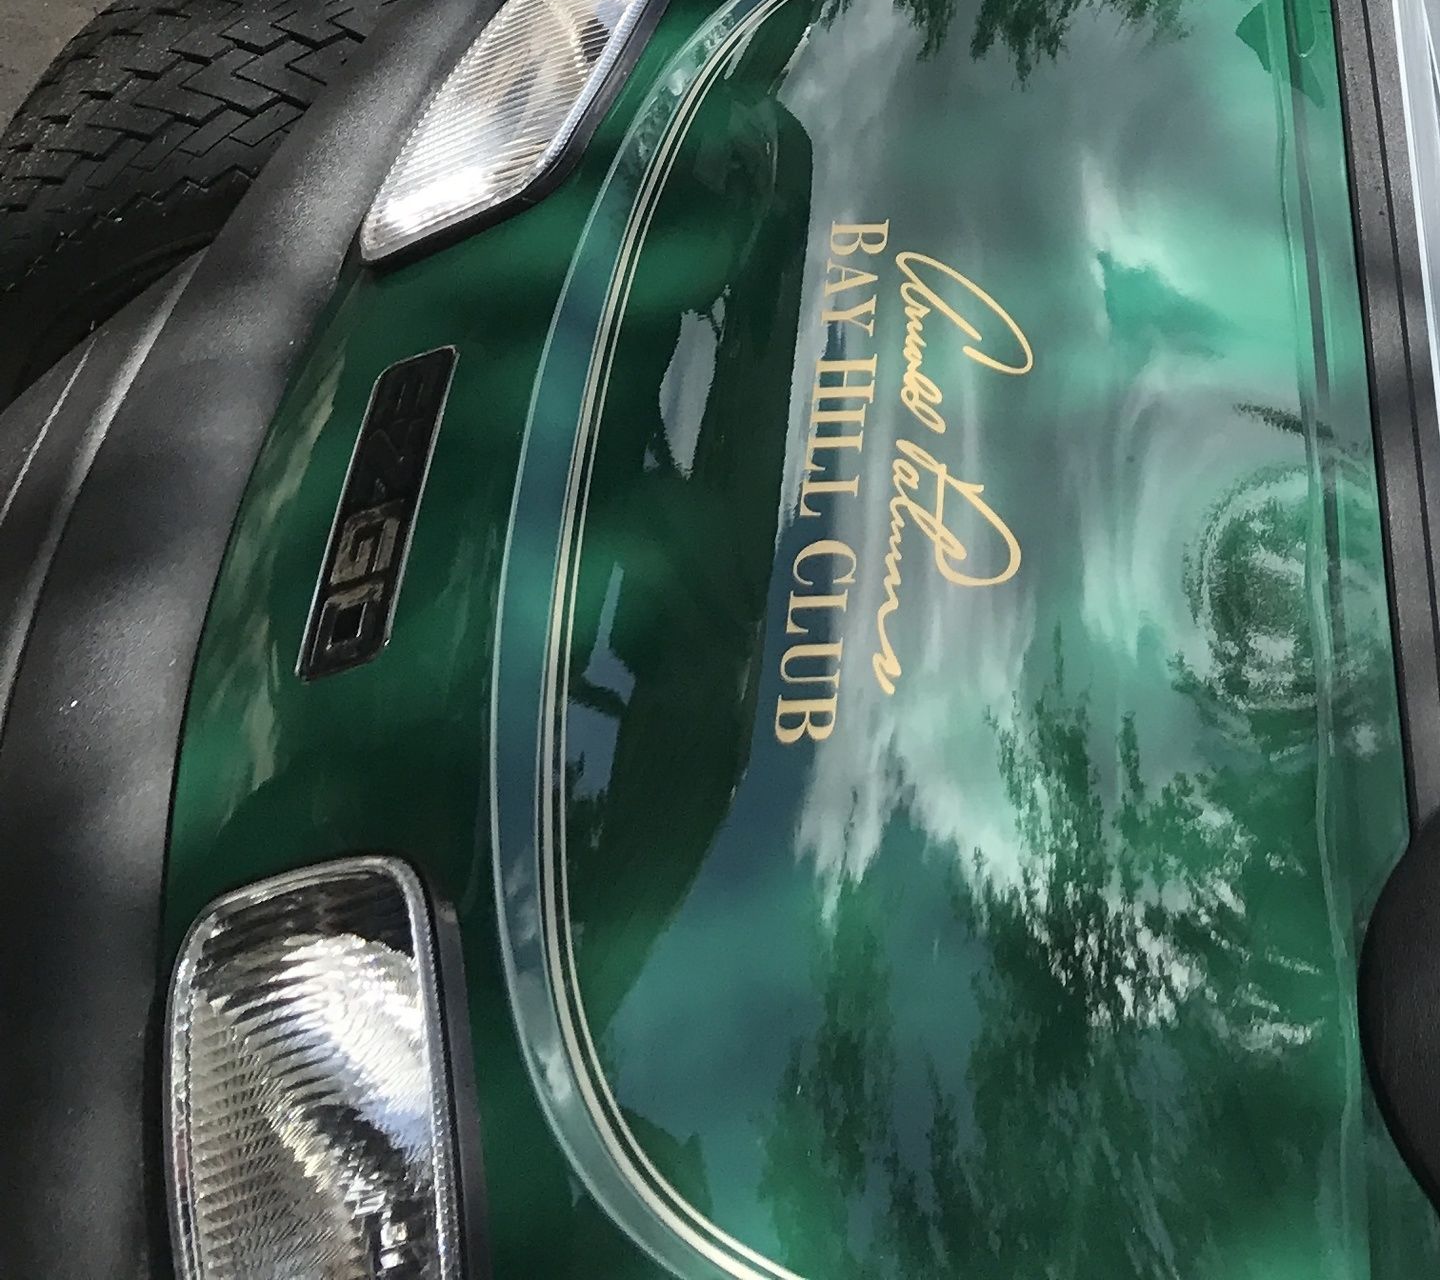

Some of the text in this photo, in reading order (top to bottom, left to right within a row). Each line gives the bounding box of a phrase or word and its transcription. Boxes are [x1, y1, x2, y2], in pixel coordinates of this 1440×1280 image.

[774, 219, 890, 745] BAY HILL CLUB
